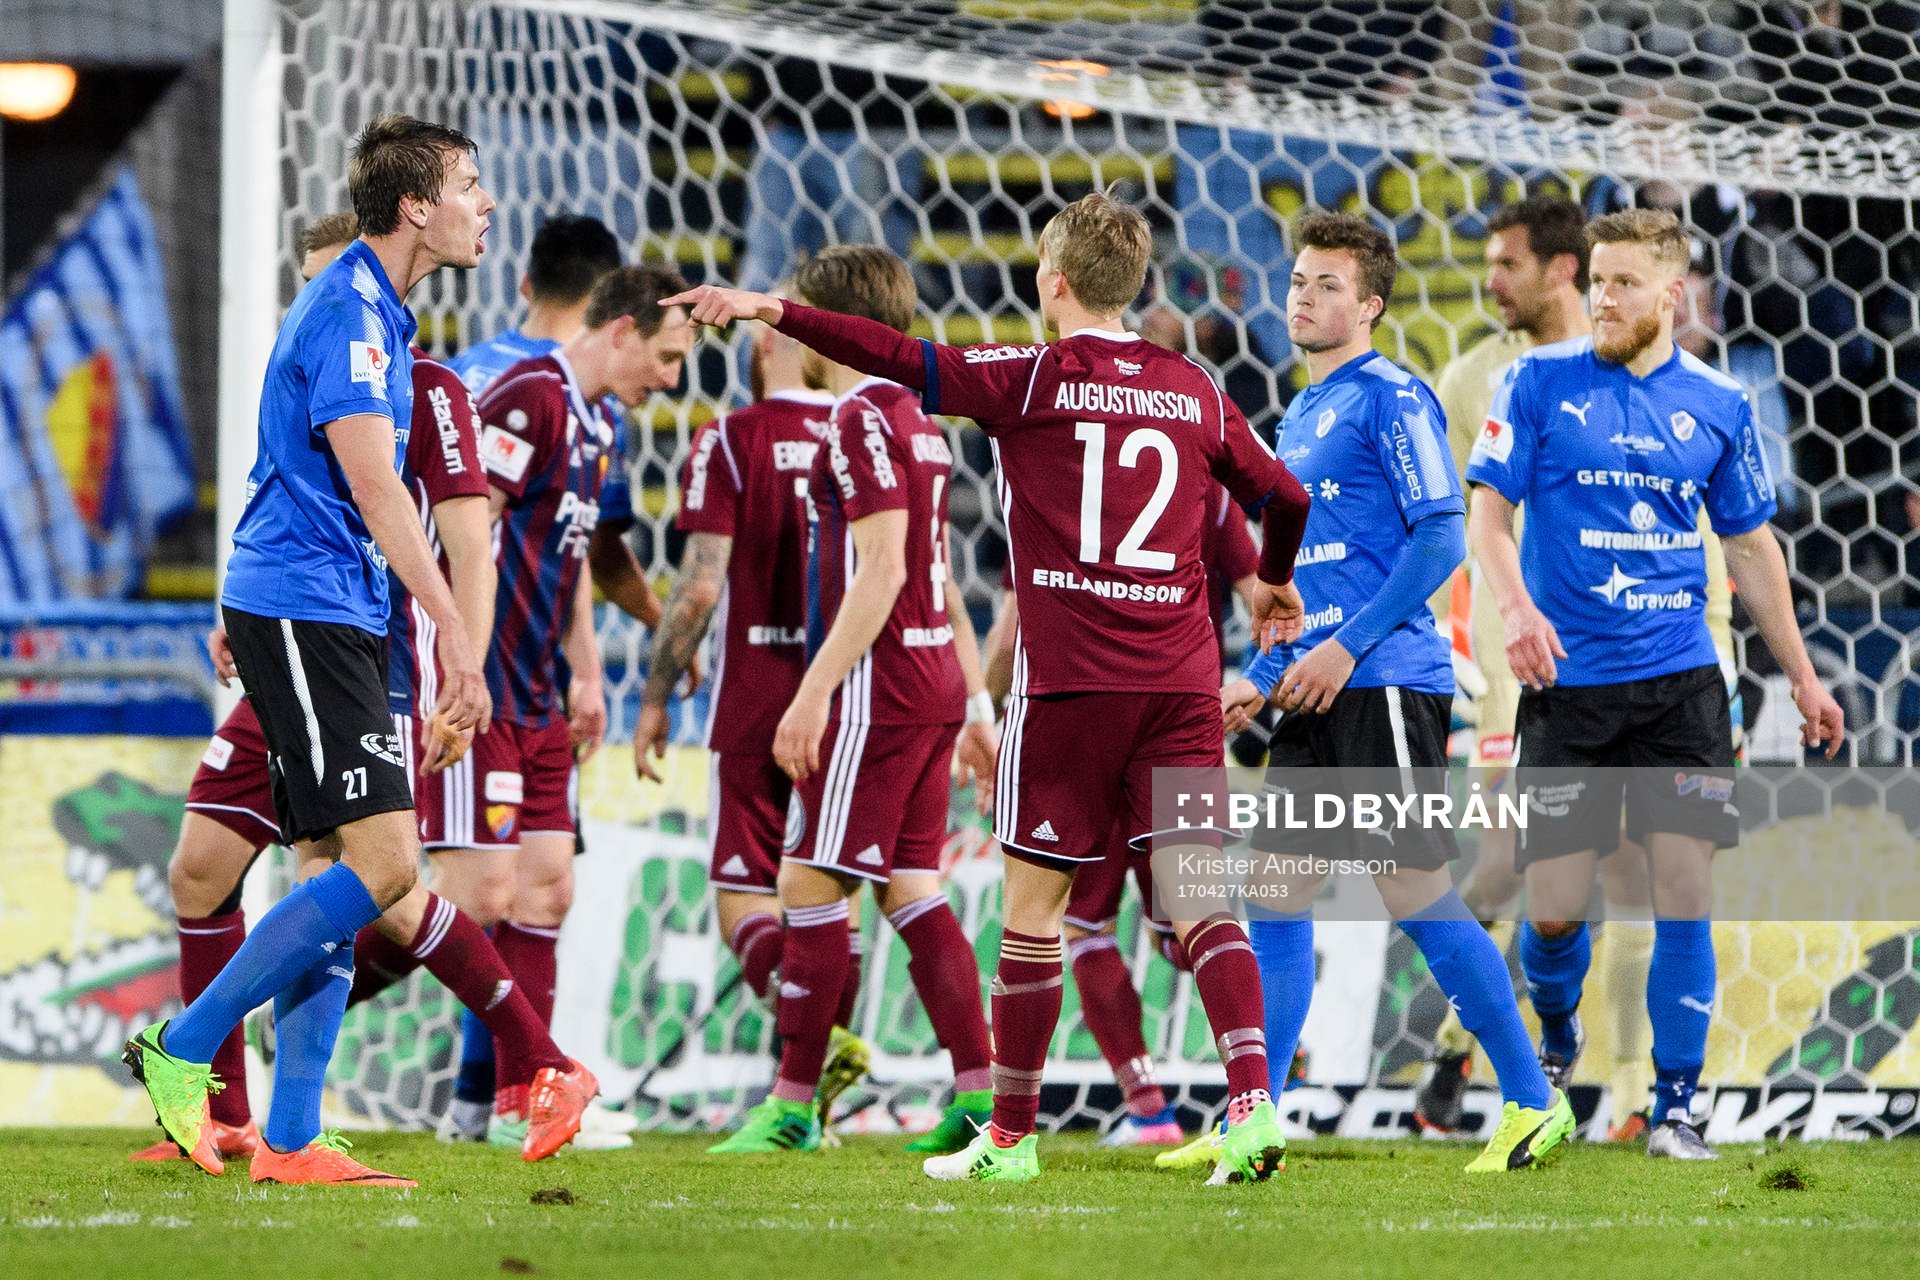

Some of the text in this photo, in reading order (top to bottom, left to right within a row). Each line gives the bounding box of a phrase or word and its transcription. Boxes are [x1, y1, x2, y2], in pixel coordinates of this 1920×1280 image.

[1054, 381, 1202, 425] AUGUSTINSSON
[1075, 422, 1179, 571] 12
[1576, 469, 1674, 493] GETINGE
[1579, 528, 1702, 551] MOTORHALLAND
[1032, 568, 1184, 604] ERLANDSSON
[1625, 588, 1692, 611] bravida
[342, 766, 367, 801] 27
